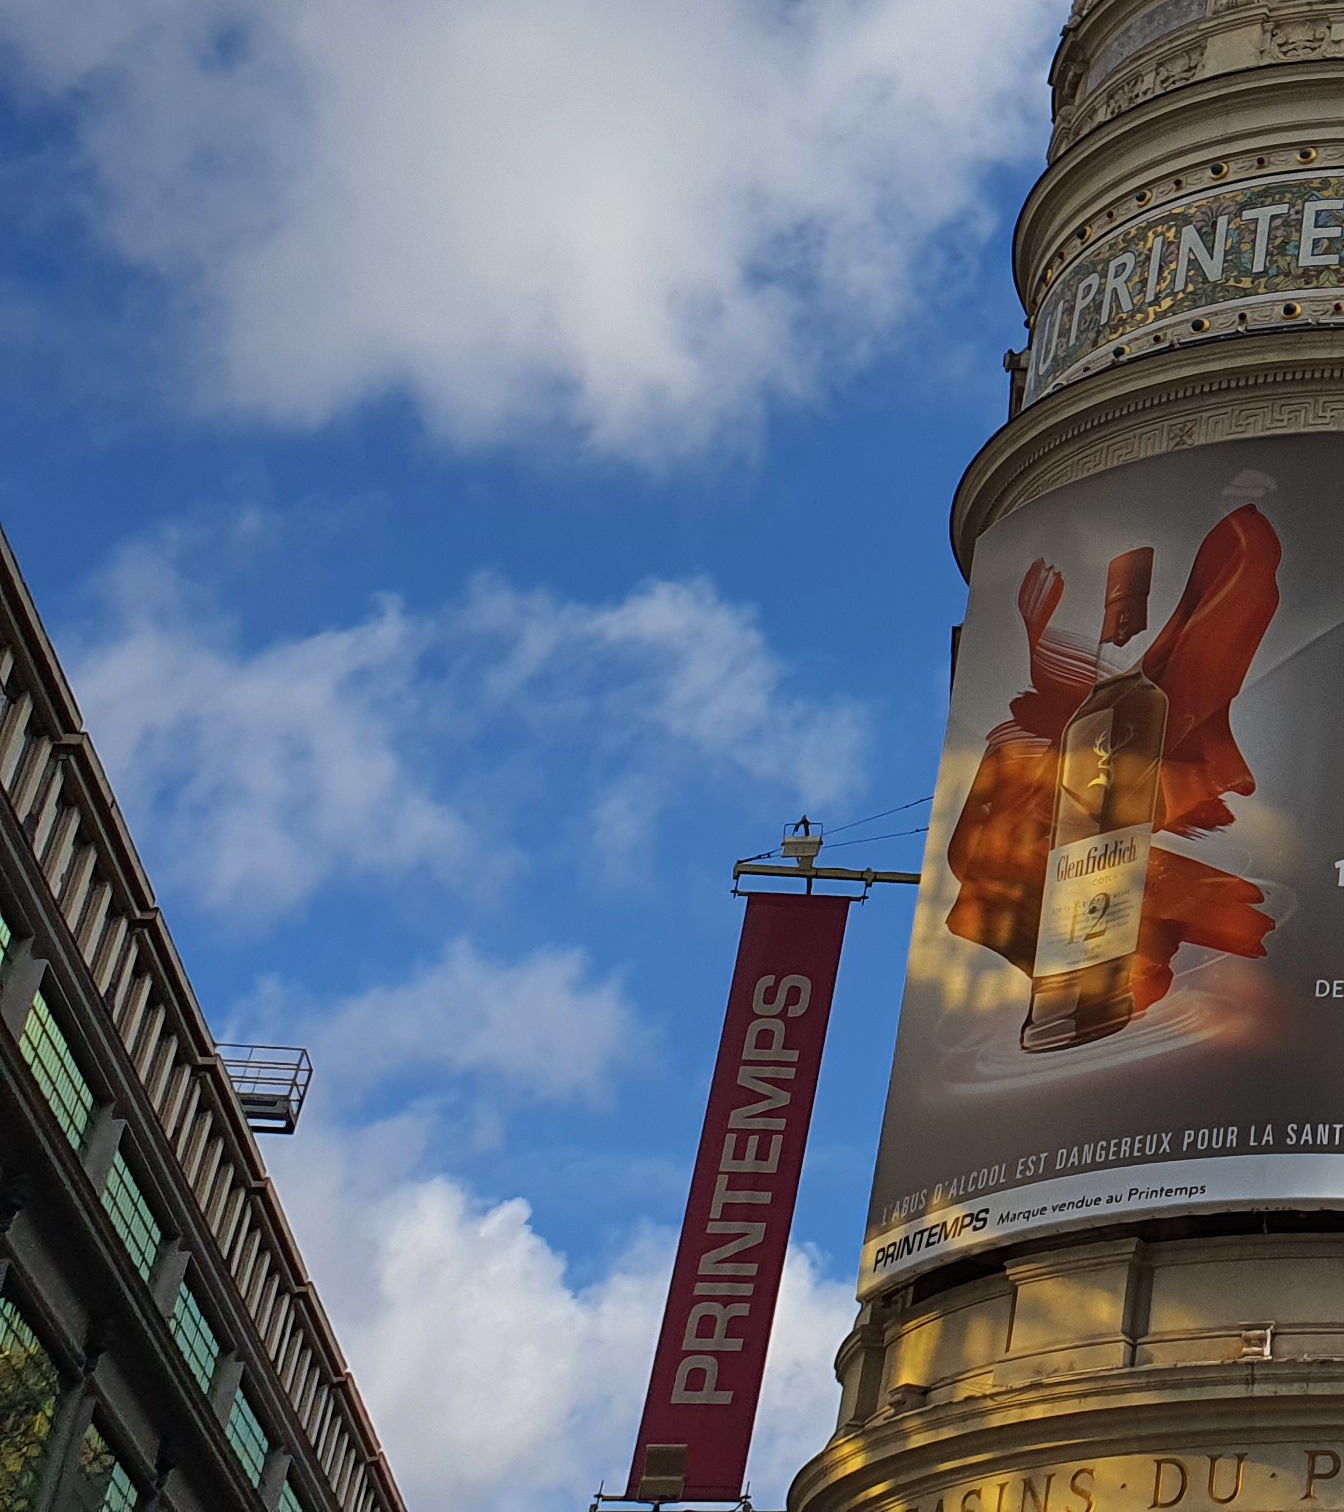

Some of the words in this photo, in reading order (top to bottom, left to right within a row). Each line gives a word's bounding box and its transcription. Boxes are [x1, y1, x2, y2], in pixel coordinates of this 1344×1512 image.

[1056, 837, 1137, 883] Glenfiddich
[1315, 979, 1344, 998] DE
[670, 974, 812, 1405] PRINTEMPS
[881, 1189, 927, 1226] L'ABUS
[932, 1162, 1007, 1205] D'ALCOOL
[1016, 1152, 1048, 1179] EST
[1055, 1132, 1173, 1170] DANGEREUX
[1182, 1124, 1238, 1152] POUR
[1249, 1123, 1275, 1147] LA
[873, 1207, 990, 1273] PRINTEMPS
[997, 1204, 1048, 1226] Marque
[1051, 1194, 1102, 1214] vendue
[1106, 1194, 1123, 1205] au
[1127, 1184, 1206, 1203] Printemps
[1148, 1451, 1249, 1510] DU
